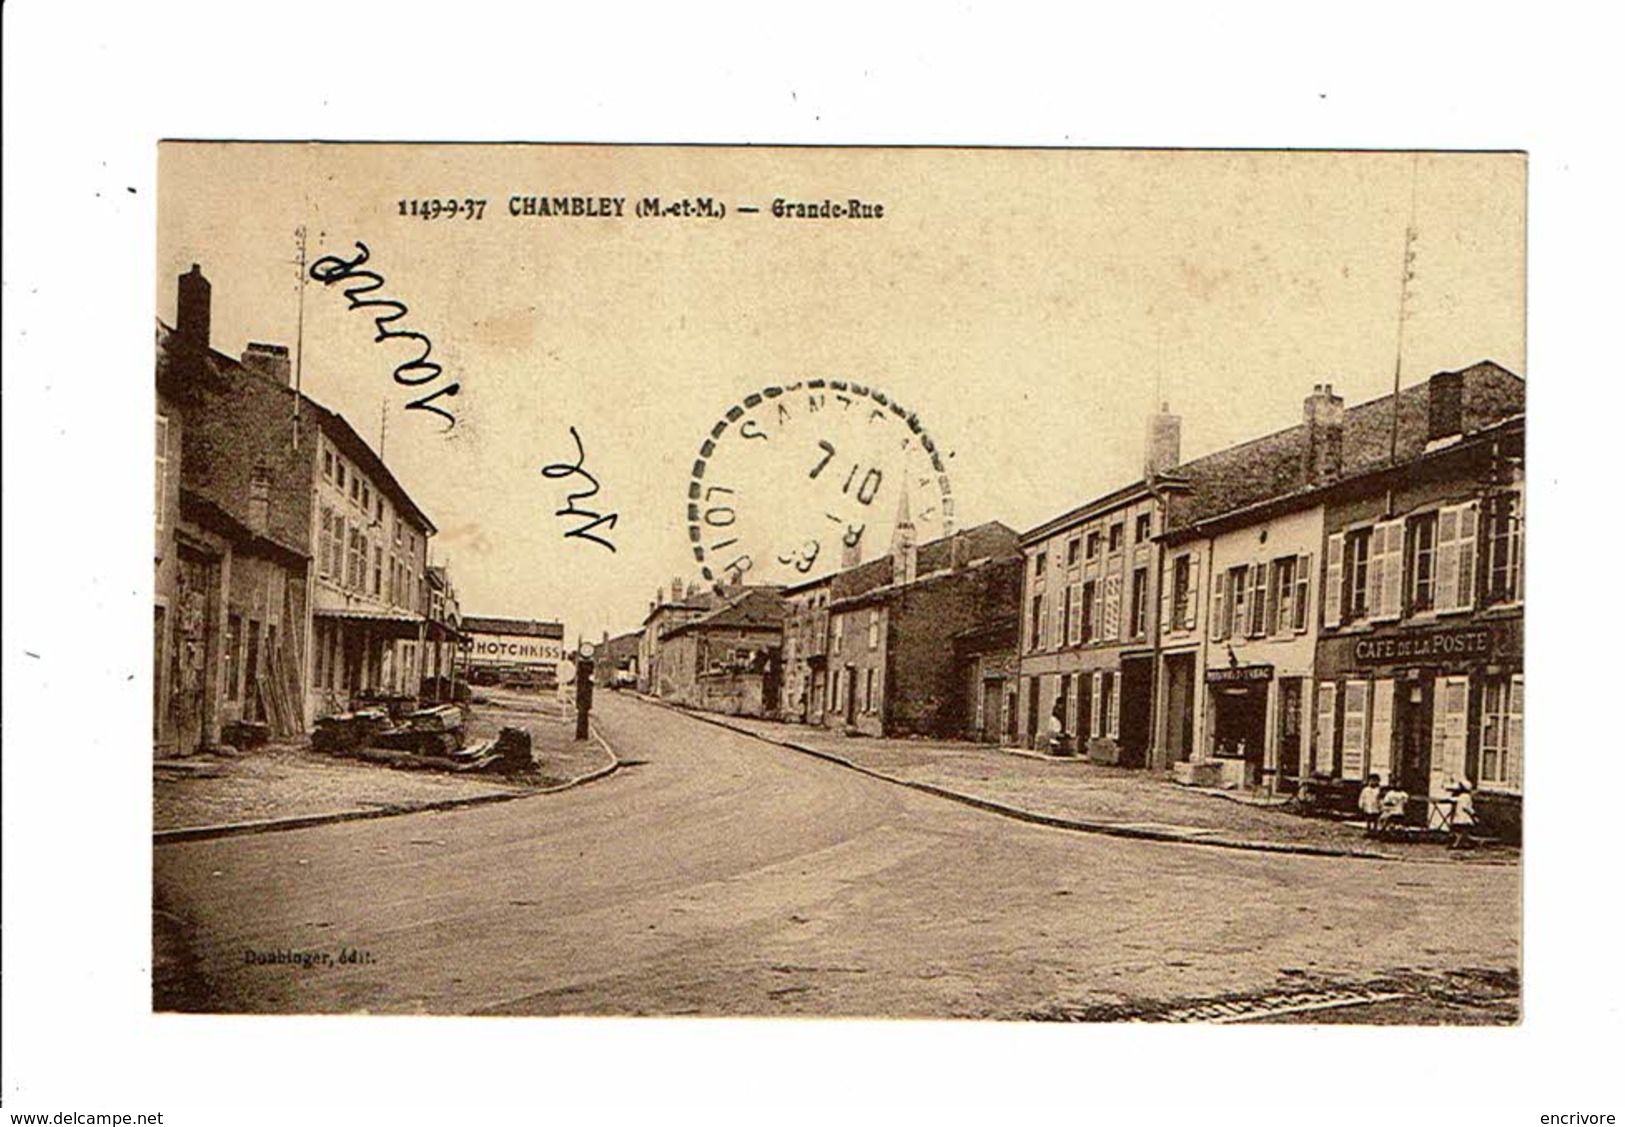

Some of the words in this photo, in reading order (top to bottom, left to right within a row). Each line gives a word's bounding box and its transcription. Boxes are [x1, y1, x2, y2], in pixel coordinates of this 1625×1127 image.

[477, 641, 560, 659] HOTCHKISS
[1413, 639, 1431, 657] LA
[1431, 631, 1489, 656] POSTE
